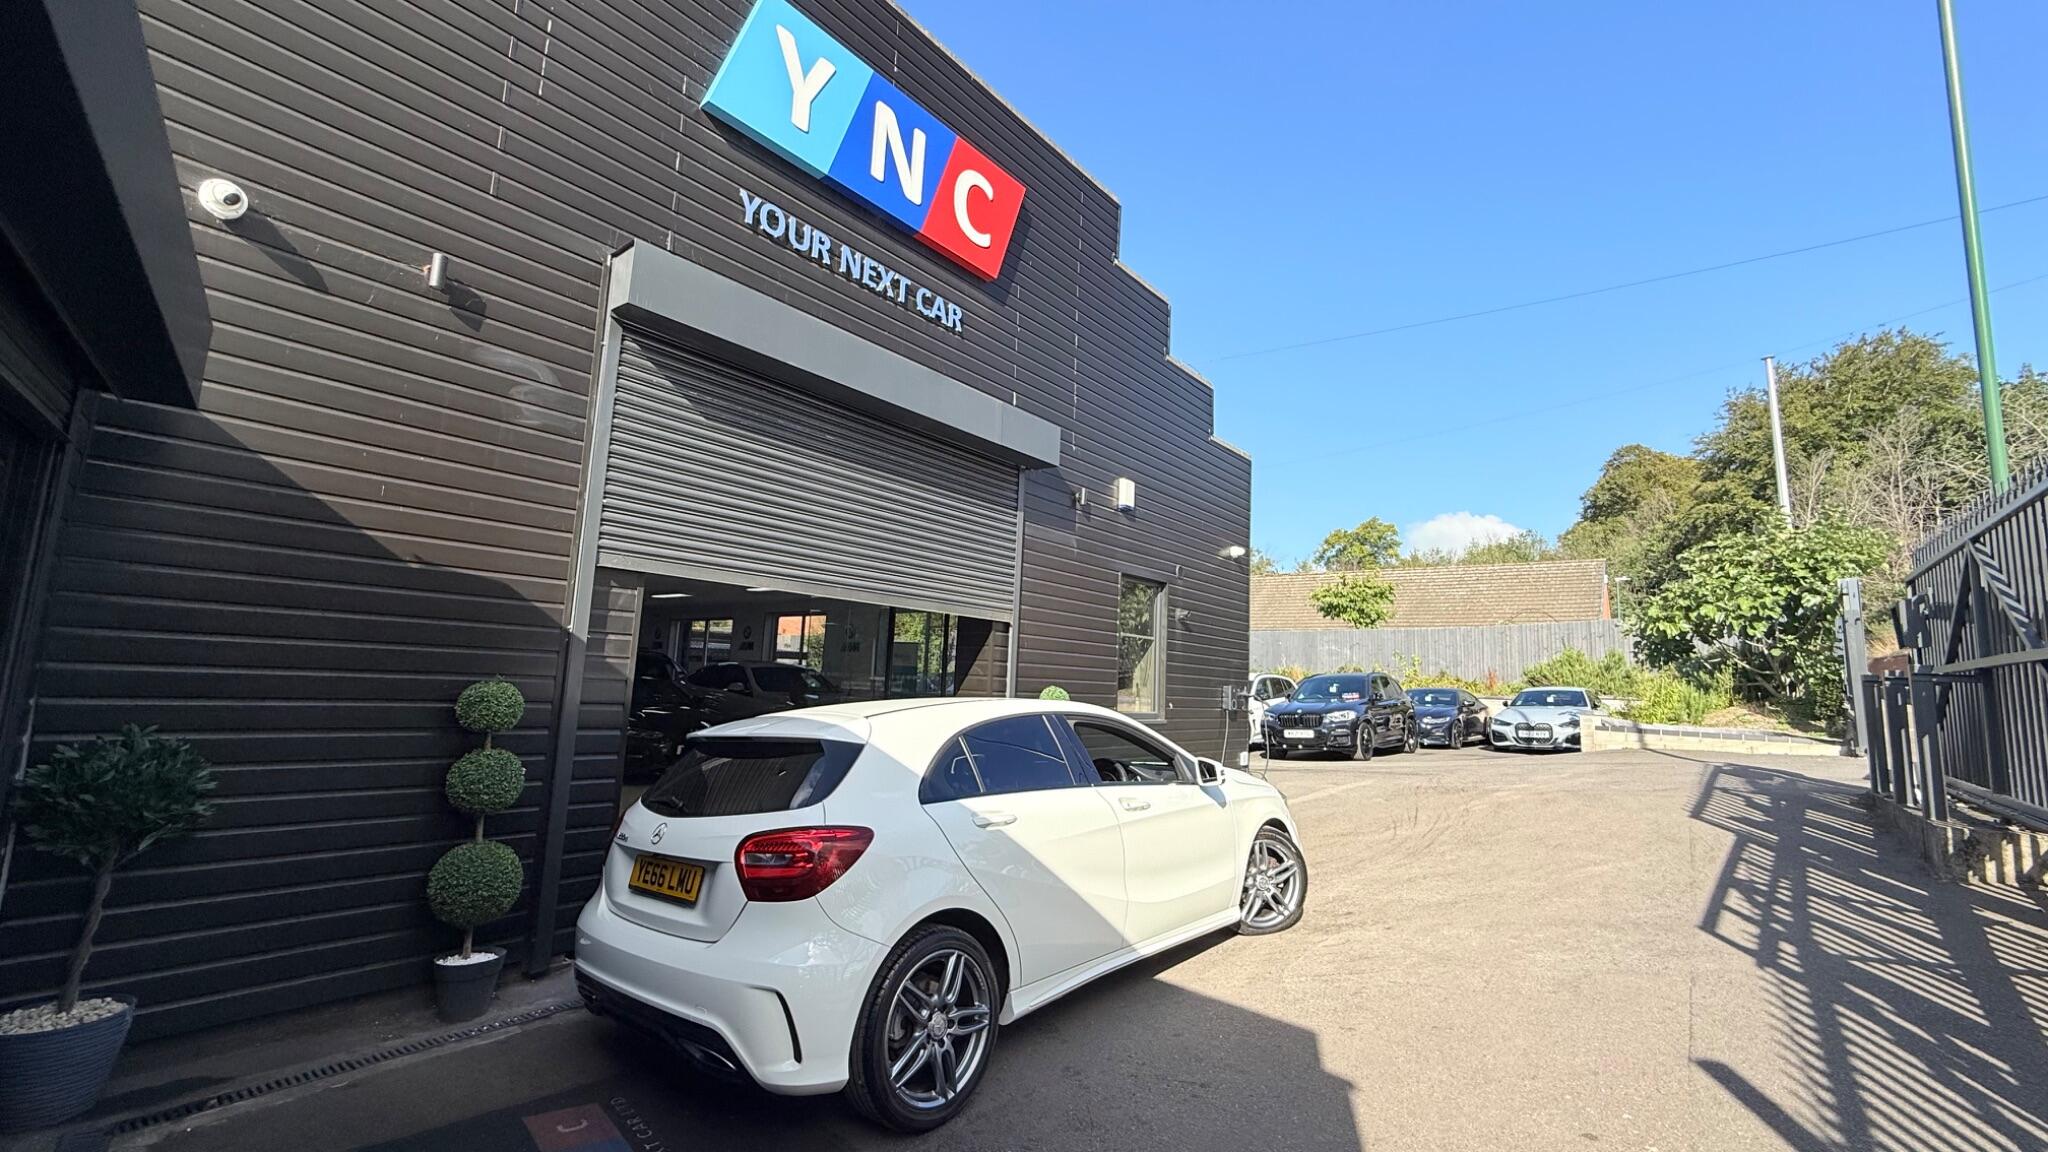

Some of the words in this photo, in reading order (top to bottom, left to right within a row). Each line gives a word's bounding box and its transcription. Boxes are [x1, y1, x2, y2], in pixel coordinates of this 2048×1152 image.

[775, 23, 994, 249] YNC
[738, 188, 832, 266] YOUR
[839, 243, 912, 304] NEXT
[916, 286, 964, 333] CAR
[636, 858, 668, 887] YE66
[668, 866, 698, 894] LMU
